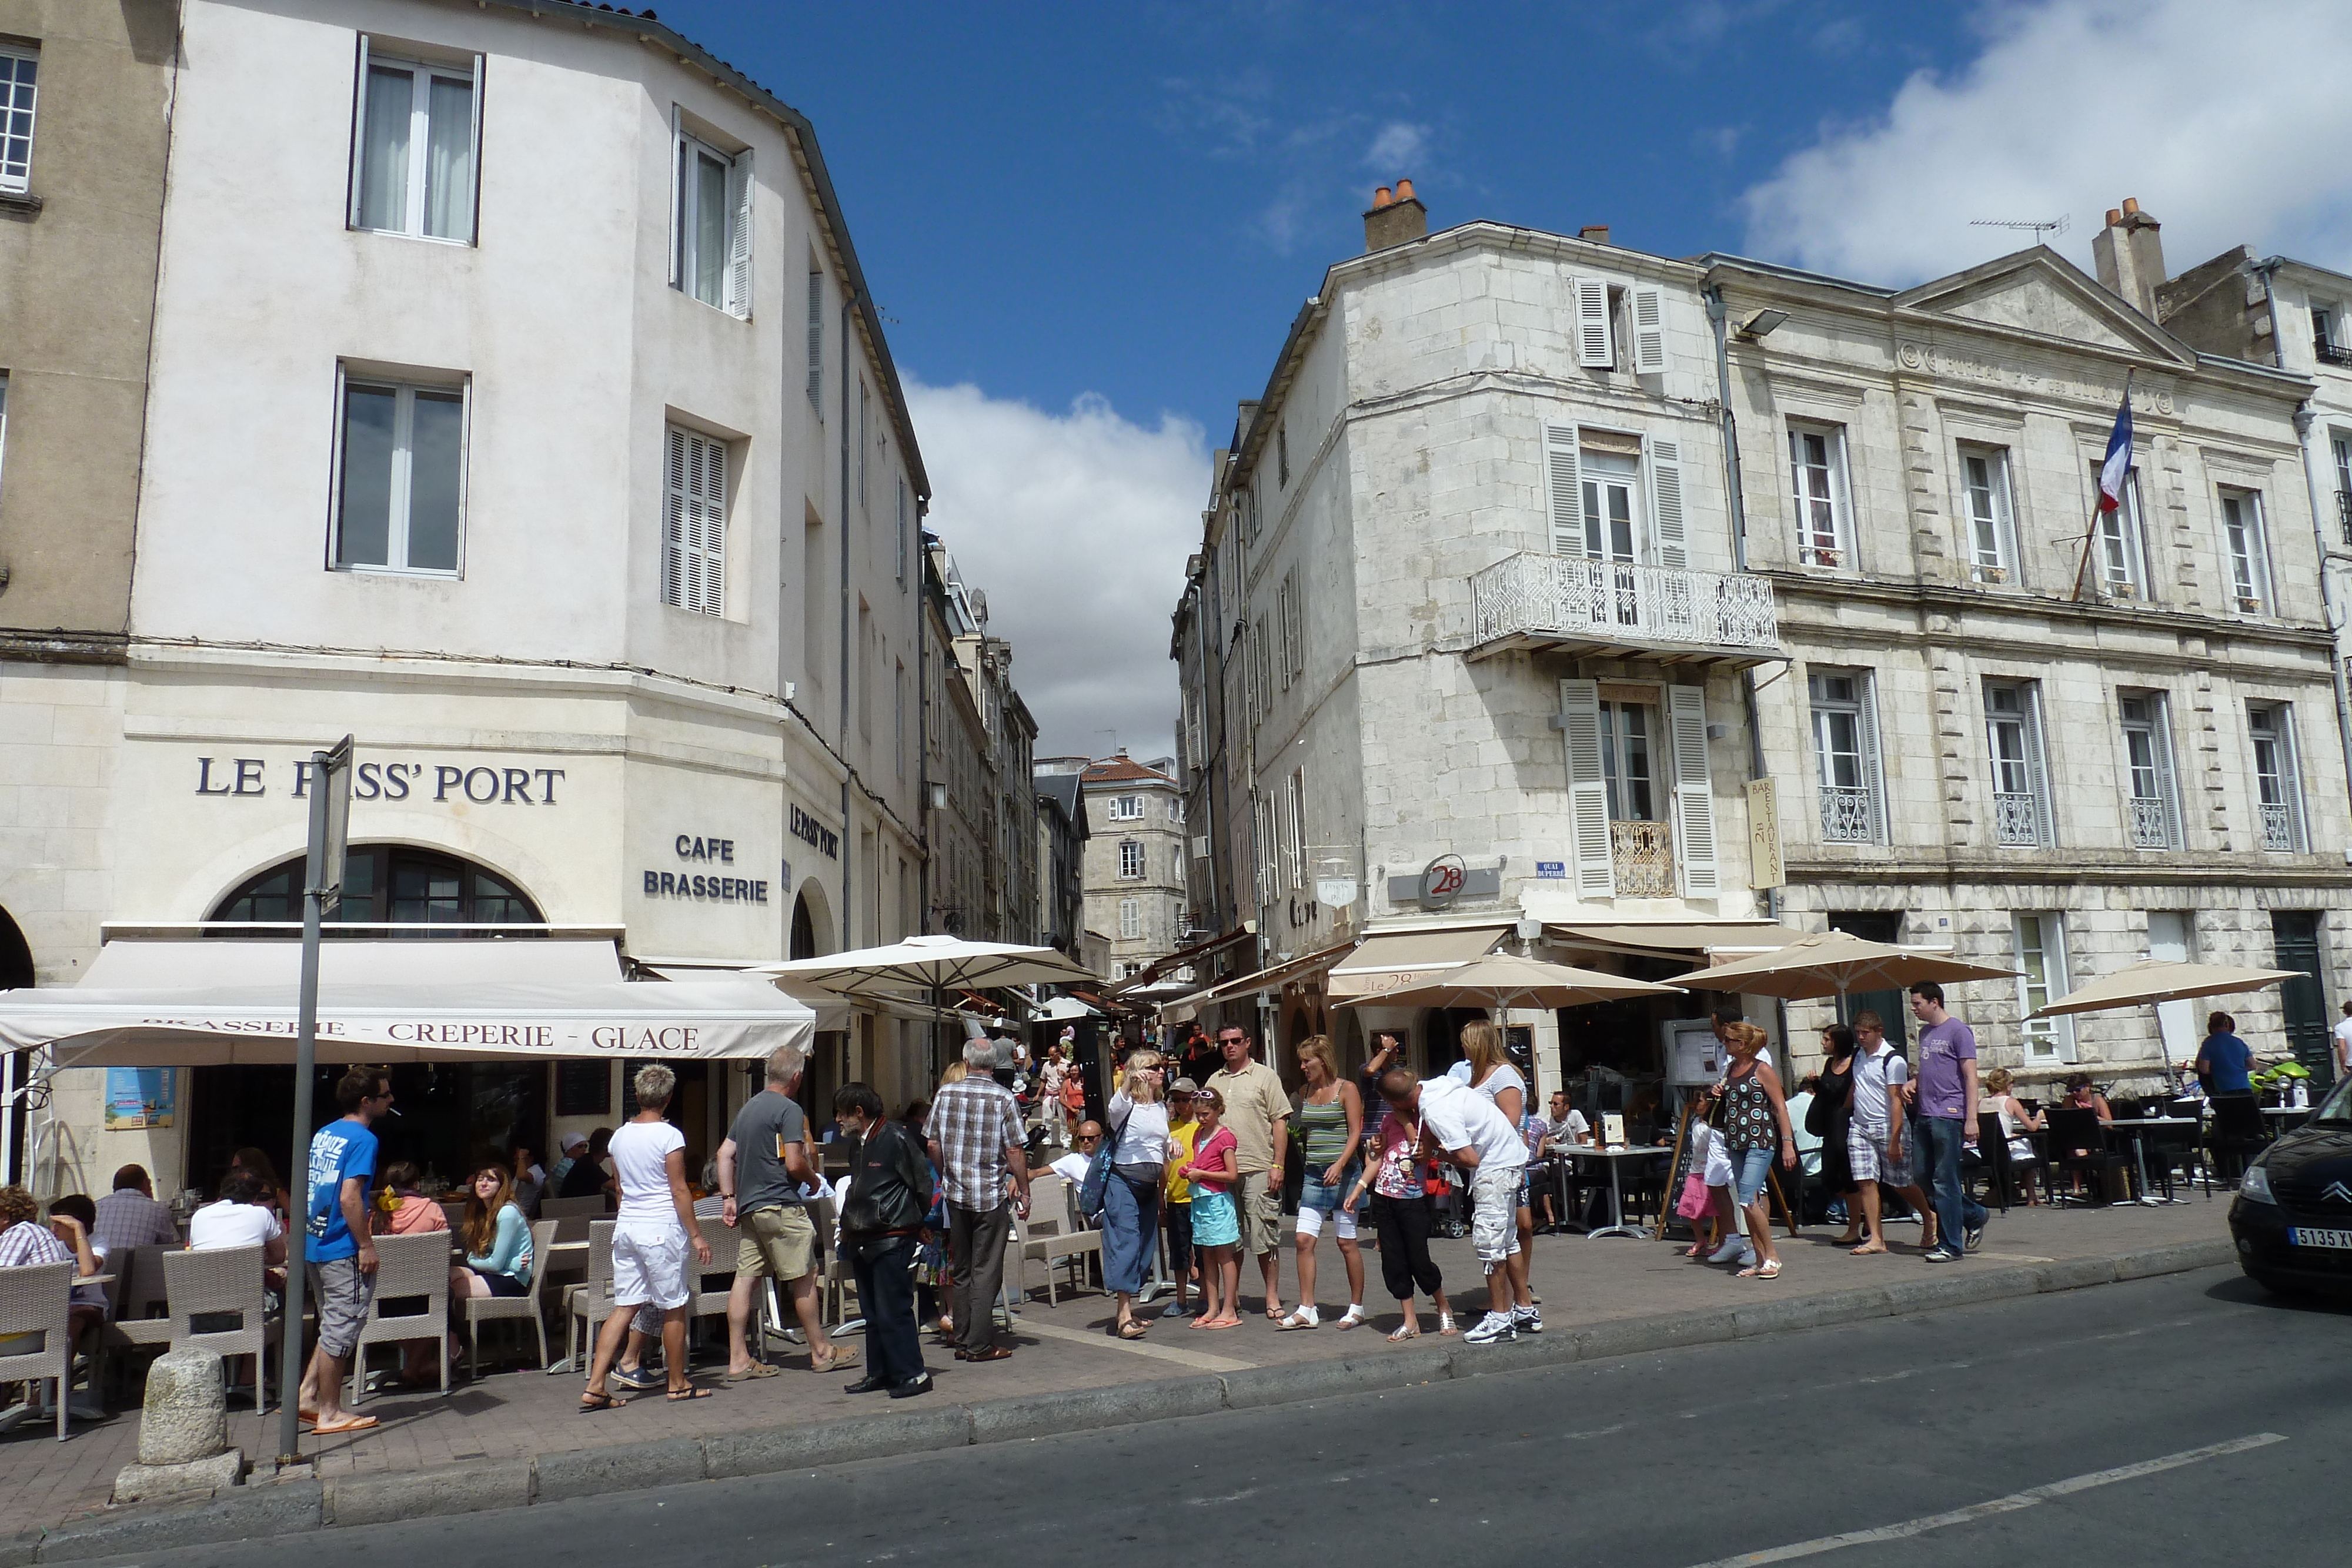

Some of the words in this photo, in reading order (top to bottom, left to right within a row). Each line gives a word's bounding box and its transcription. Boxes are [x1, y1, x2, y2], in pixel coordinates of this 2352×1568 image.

[196, 757, 266, 796] LE
[291, 761, 422, 800] PSS'
[433, 765, 565, 804] PORT
[790, 803, 801, 837] LE
[820, 825, 839, 861] PORT
[676, 835, 734, 861] CAFE
[644, 870, 768, 902] BRASSERIE
[1431, 865, 1462, 894] 28
[1372, 981, 1384, 991] Le
[388, 1023, 554, 1047] CREPERIE
[591, 1027, 700, 1050] GLACE
[2300, 1229, 2335, 1246] 5135
